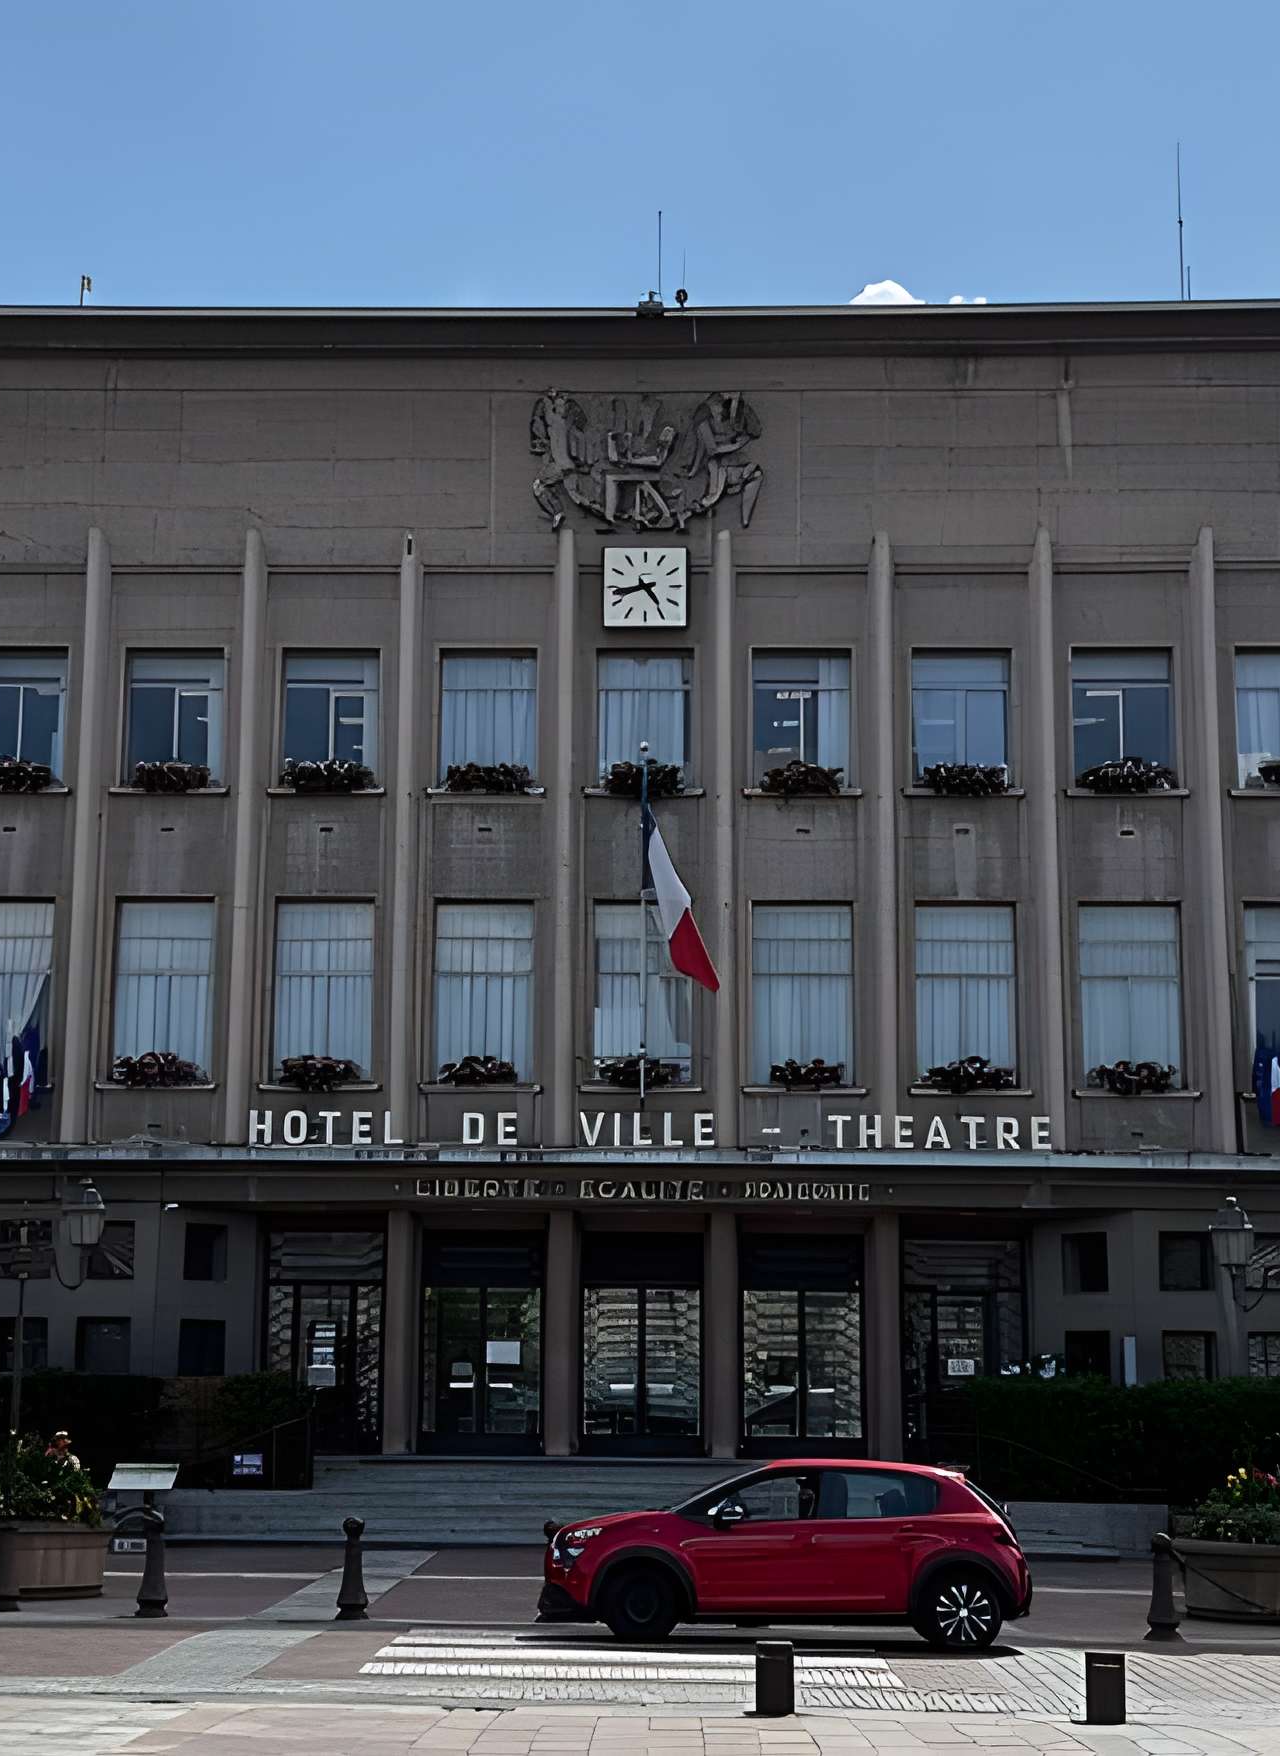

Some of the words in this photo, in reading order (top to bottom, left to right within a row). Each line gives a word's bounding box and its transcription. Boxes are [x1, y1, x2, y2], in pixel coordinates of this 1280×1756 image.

[249, 1109, 404, 1145] HOTEL
[462, 1111, 518, 1145] DE
[579, 1112, 715, 1146] VILLE
[827, 1115, 1052, 1150] THEATRE
